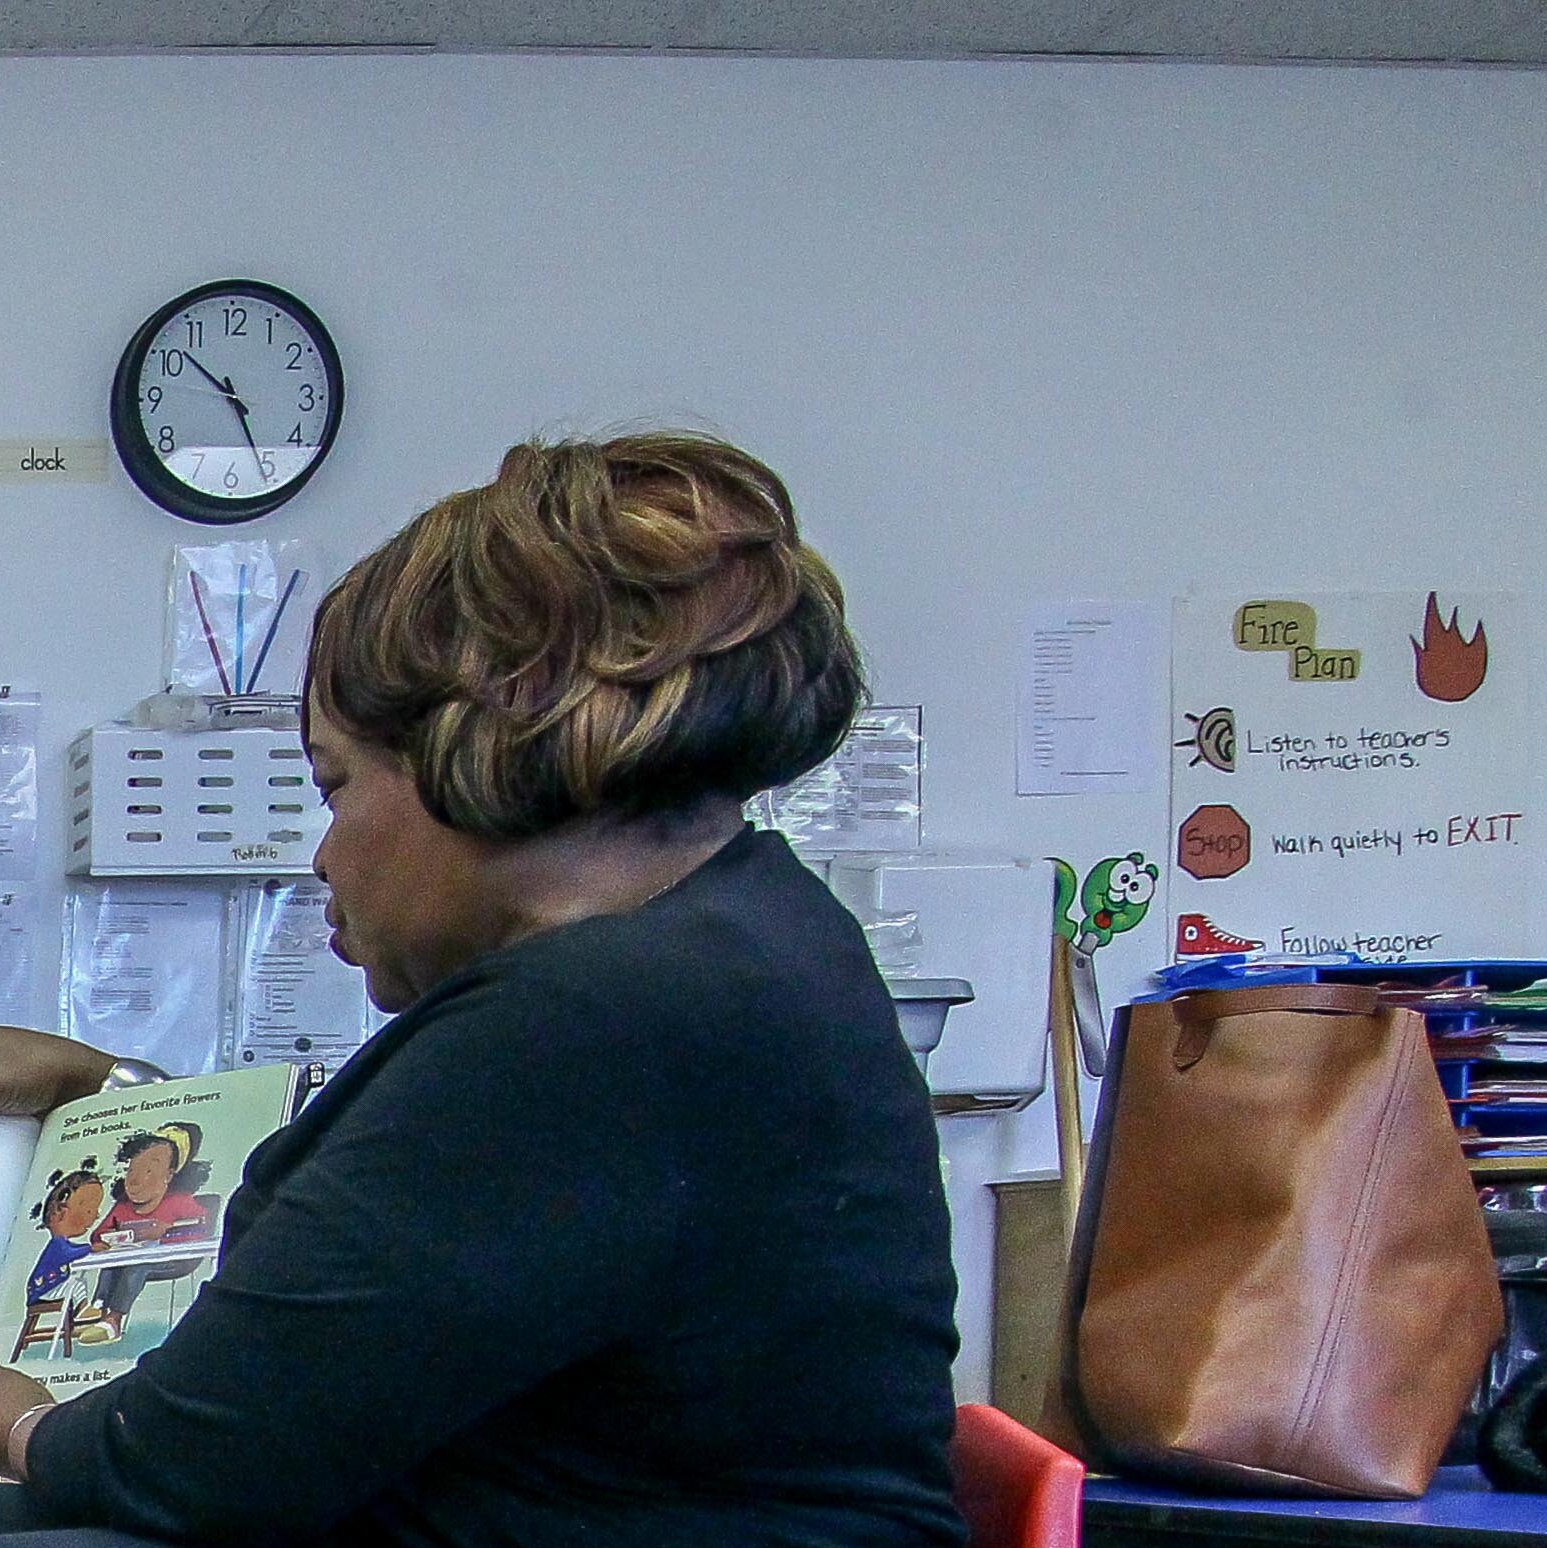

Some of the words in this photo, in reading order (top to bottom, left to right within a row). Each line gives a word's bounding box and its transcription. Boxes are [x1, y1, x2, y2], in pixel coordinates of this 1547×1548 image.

[186, 320, 203, 348] 11
[223, 308, 248, 337] 12
[265, 316, 274, 346] 1
[159, 349, 184, 377] 10
[285, 342, 303, 370] 2
[147, 386, 164, 414] 9
[298, 384, 315, 412] 3
[158, 425, 175, 453] 8
[286, 421, 304, 447] 4
[21, 447, 66, 472] clock
[191, 453, 206, 480] 7
[260, 450, 276, 479] 5
[222, 461, 239, 490] 6
[1239, 604, 1299, 645] Fire
[1294, 645, 1357, 680] Plan
[1246, 728, 1316, 754] Listen
[1325, 731, 1348, 749] to
[1356, 727, 1451, 749] teacher's
[1331, 829, 1402, 859] quietly
[1412, 827, 1439, 845] to
[1446, 813, 1523, 848] EXIT.
[1352, 931, 1443, 954] teacher
[63, 1115, 80, 1128] She
[80, 1106, 118, 1124] chooses
[120, 1103, 138, 1116] her
[140, 1097, 181, 1113] favorite
[183, 1090, 222, 1106] flowers
[59, 1131, 81, 1144] from
[82, 1125, 99, 1138] the
[100, 1120, 132, 1135] books.
[50, 1372, 81, 1384] makes
[82, 1374, 90, 1382] a
